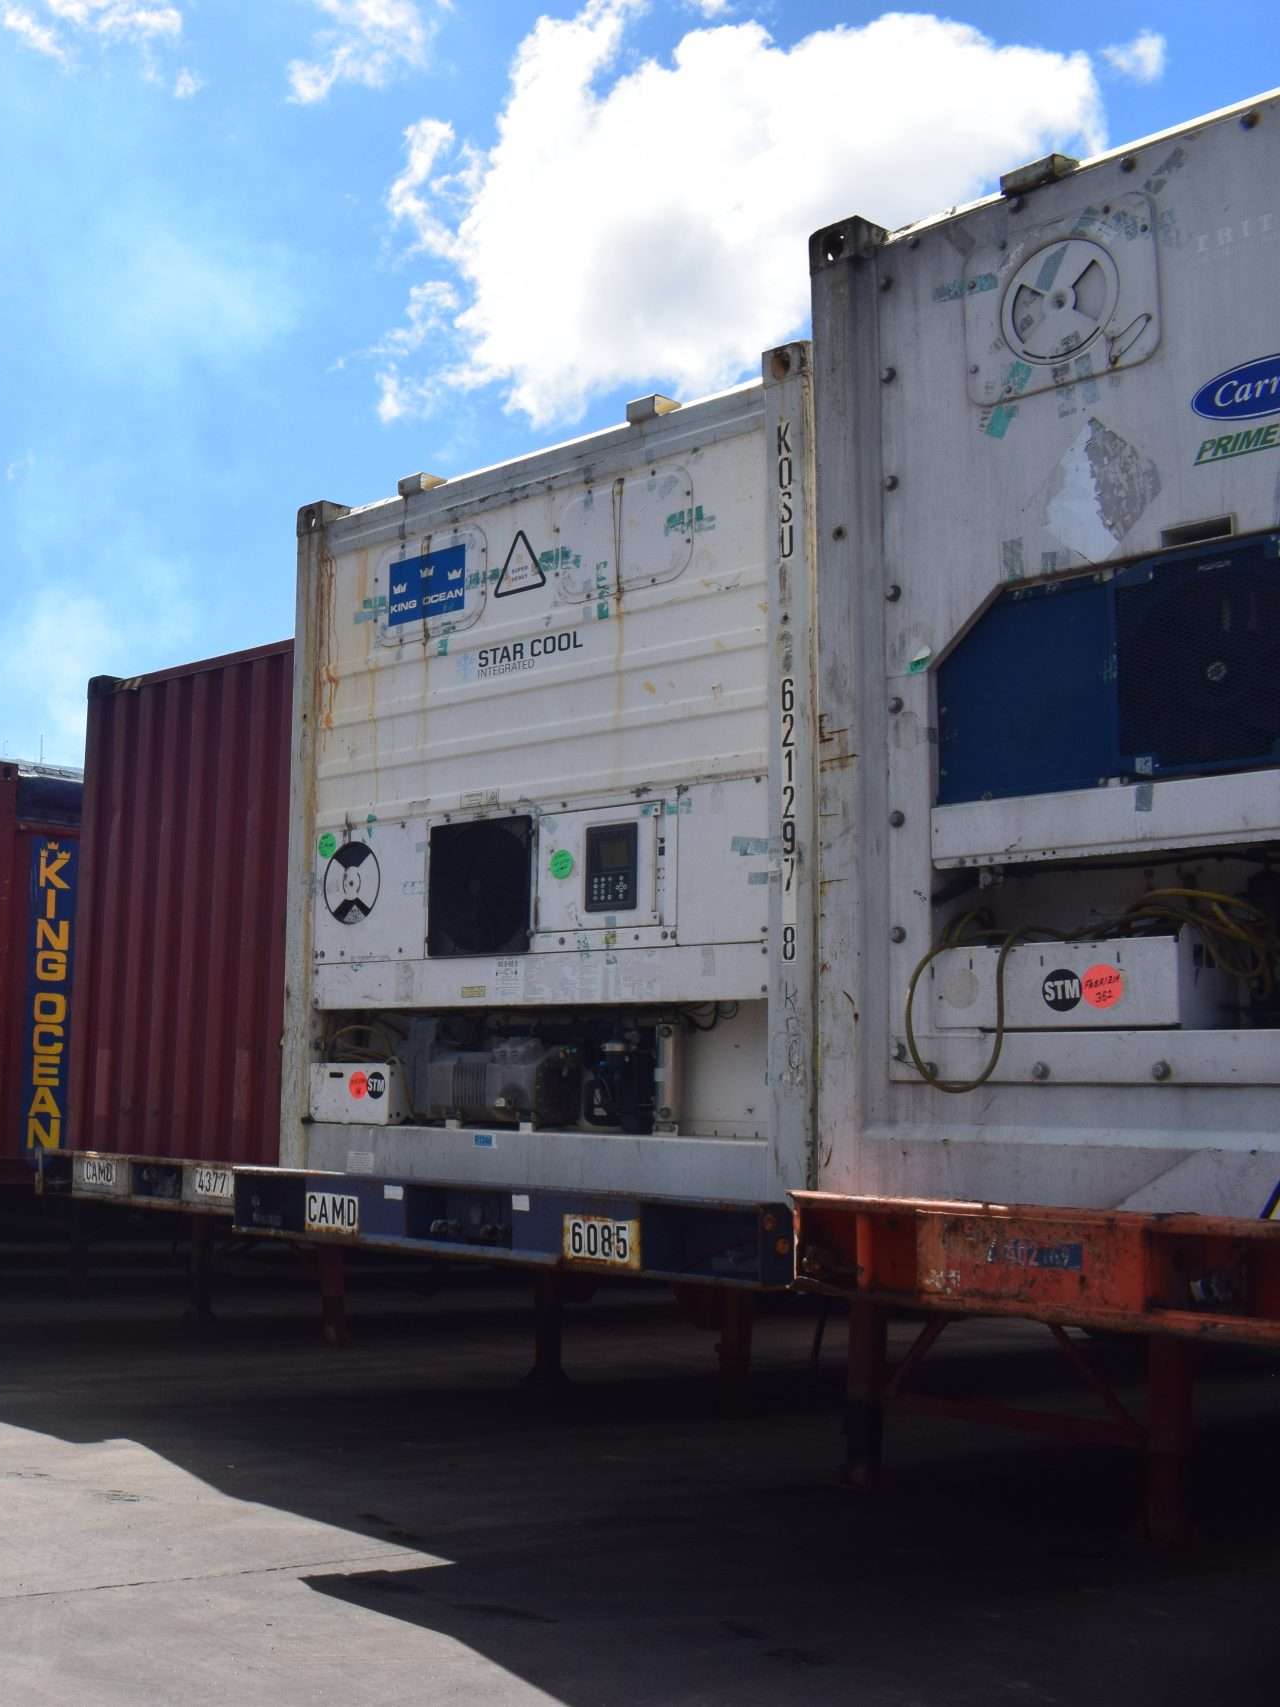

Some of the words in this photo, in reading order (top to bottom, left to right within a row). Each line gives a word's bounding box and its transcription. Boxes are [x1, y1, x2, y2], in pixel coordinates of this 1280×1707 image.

[390, 599, 417, 614] KING
[422, 587, 464, 606] OCEAN
[478, 642, 524, 668] STAR
[530, 630, 584, 657] COOL
[477, 658, 535, 680] INTEGRATED
[35, 852, 71, 981] KING
[1044, 978, 1081, 1002] STM
[27, 991, 67, 1149] OCEAN
[367, 1078, 385, 1093] STM
[86, 1160, 113, 1183] CAMD
[198, 1169, 227, 1194] 4377
[308, 1194, 357, 1228] CAMD
[571, 1221, 628, 1260] 6085
